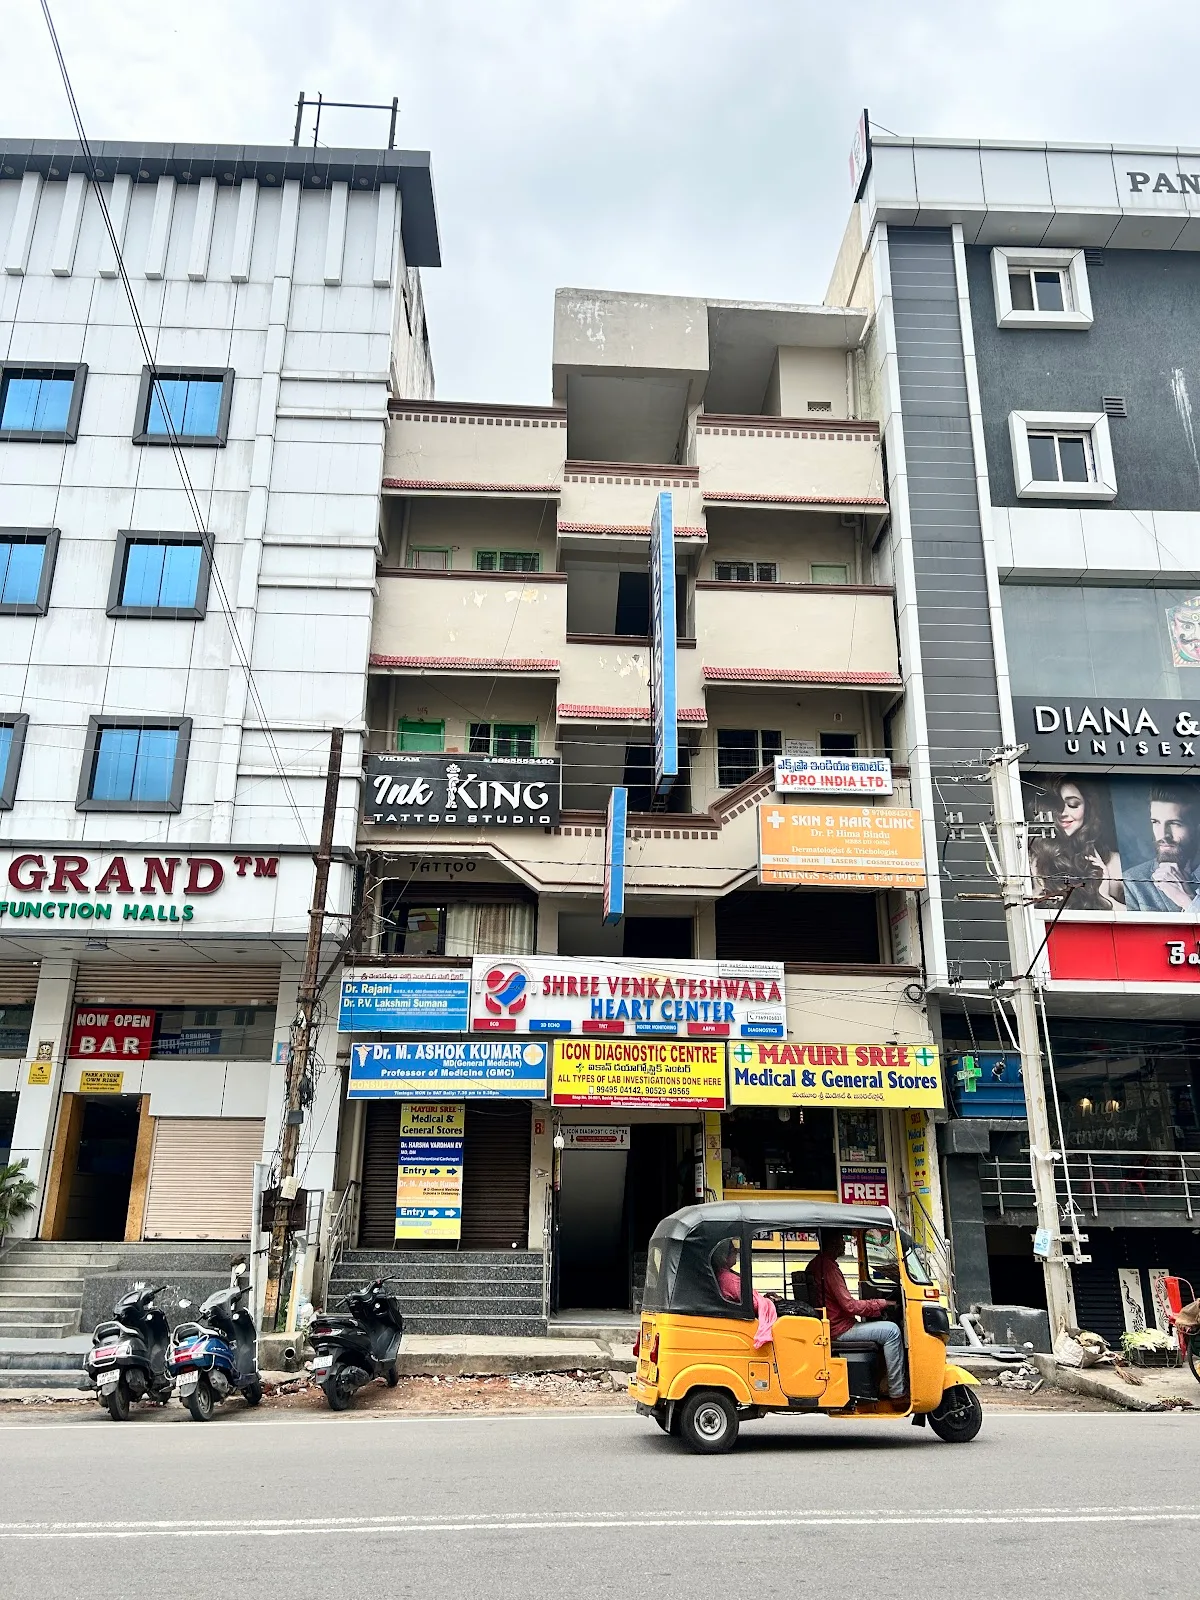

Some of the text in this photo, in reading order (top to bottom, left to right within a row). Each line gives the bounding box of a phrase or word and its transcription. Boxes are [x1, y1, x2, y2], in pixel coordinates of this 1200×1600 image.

[1034, 705, 1200, 736] DIANA &
[1066, 739, 1196, 757] UNISEX
[378, 755, 421, 763] VIKRAM
[373, 764, 549, 811] Ink KING
[781, 774, 888, 788] XPRO INDIA LTD.
[373, 813, 551, 825] TATTOO STUDIO
[791, 814, 915, 830] SKIN & HAIR CLINIC
[810, 829, 890, 839] Dr. P. Hima Bindu
[791, 845, 898, 857] Dermatologist & Trichologist
[409, 861, 477, 873] TATTOO
[8, 854, 225, 895] GRAND
[771, 871, 820, 880] TIMINGS
[0, 901, 195, 921] FUNCTION HALLS
[345, 984, 358, 994] Dr.
[361, 983, 392, 996] Rajani
[543, 975, 782, 1001] SHREE VENKATESHWARA
[343, 998, 448, 1008] Dr. P.V. Lakshmi Sumana
[590, 998, 736, 1023] HEART CENTER
[76, 1013, 150, 1028] NOW OPEN
[79, 1036, 140, 1054] BAR
[373, 1044, 522, 1060] Dr. M. ASHOK KUMAR
[562, 1043, 717, 1063] ICON DIAGNOSTIC CENTRE
[757, 1044, 911, 1067] MAYURI SREE
[443, 1060, 522, 1068] MD(General Medicine)
[381, 1069, 515, 1078] Professor of Medicine (GMC)
[557, 1074, 722, 1086] ALL TYPES OF LAB INVESTIGATIONS DONE HERE
[734, 1067, 937, 1089] Medical & General Stores
[596, 1086, 618, 1094] 99495
[645, 1087, 667, 1095] 90529
[411, 1114, 455, 1123] Medical &
[402, 1125, 463, 1135] General Stores
[408, 1141, 429, 1149] HARSHA
[430, 1141, 455, 1149] VARDHAN
[403, 1166, 427, 1175] Entry
[843, 1182, 887, 1200] FREE
[400, 1207, 426, 1217] Entry
